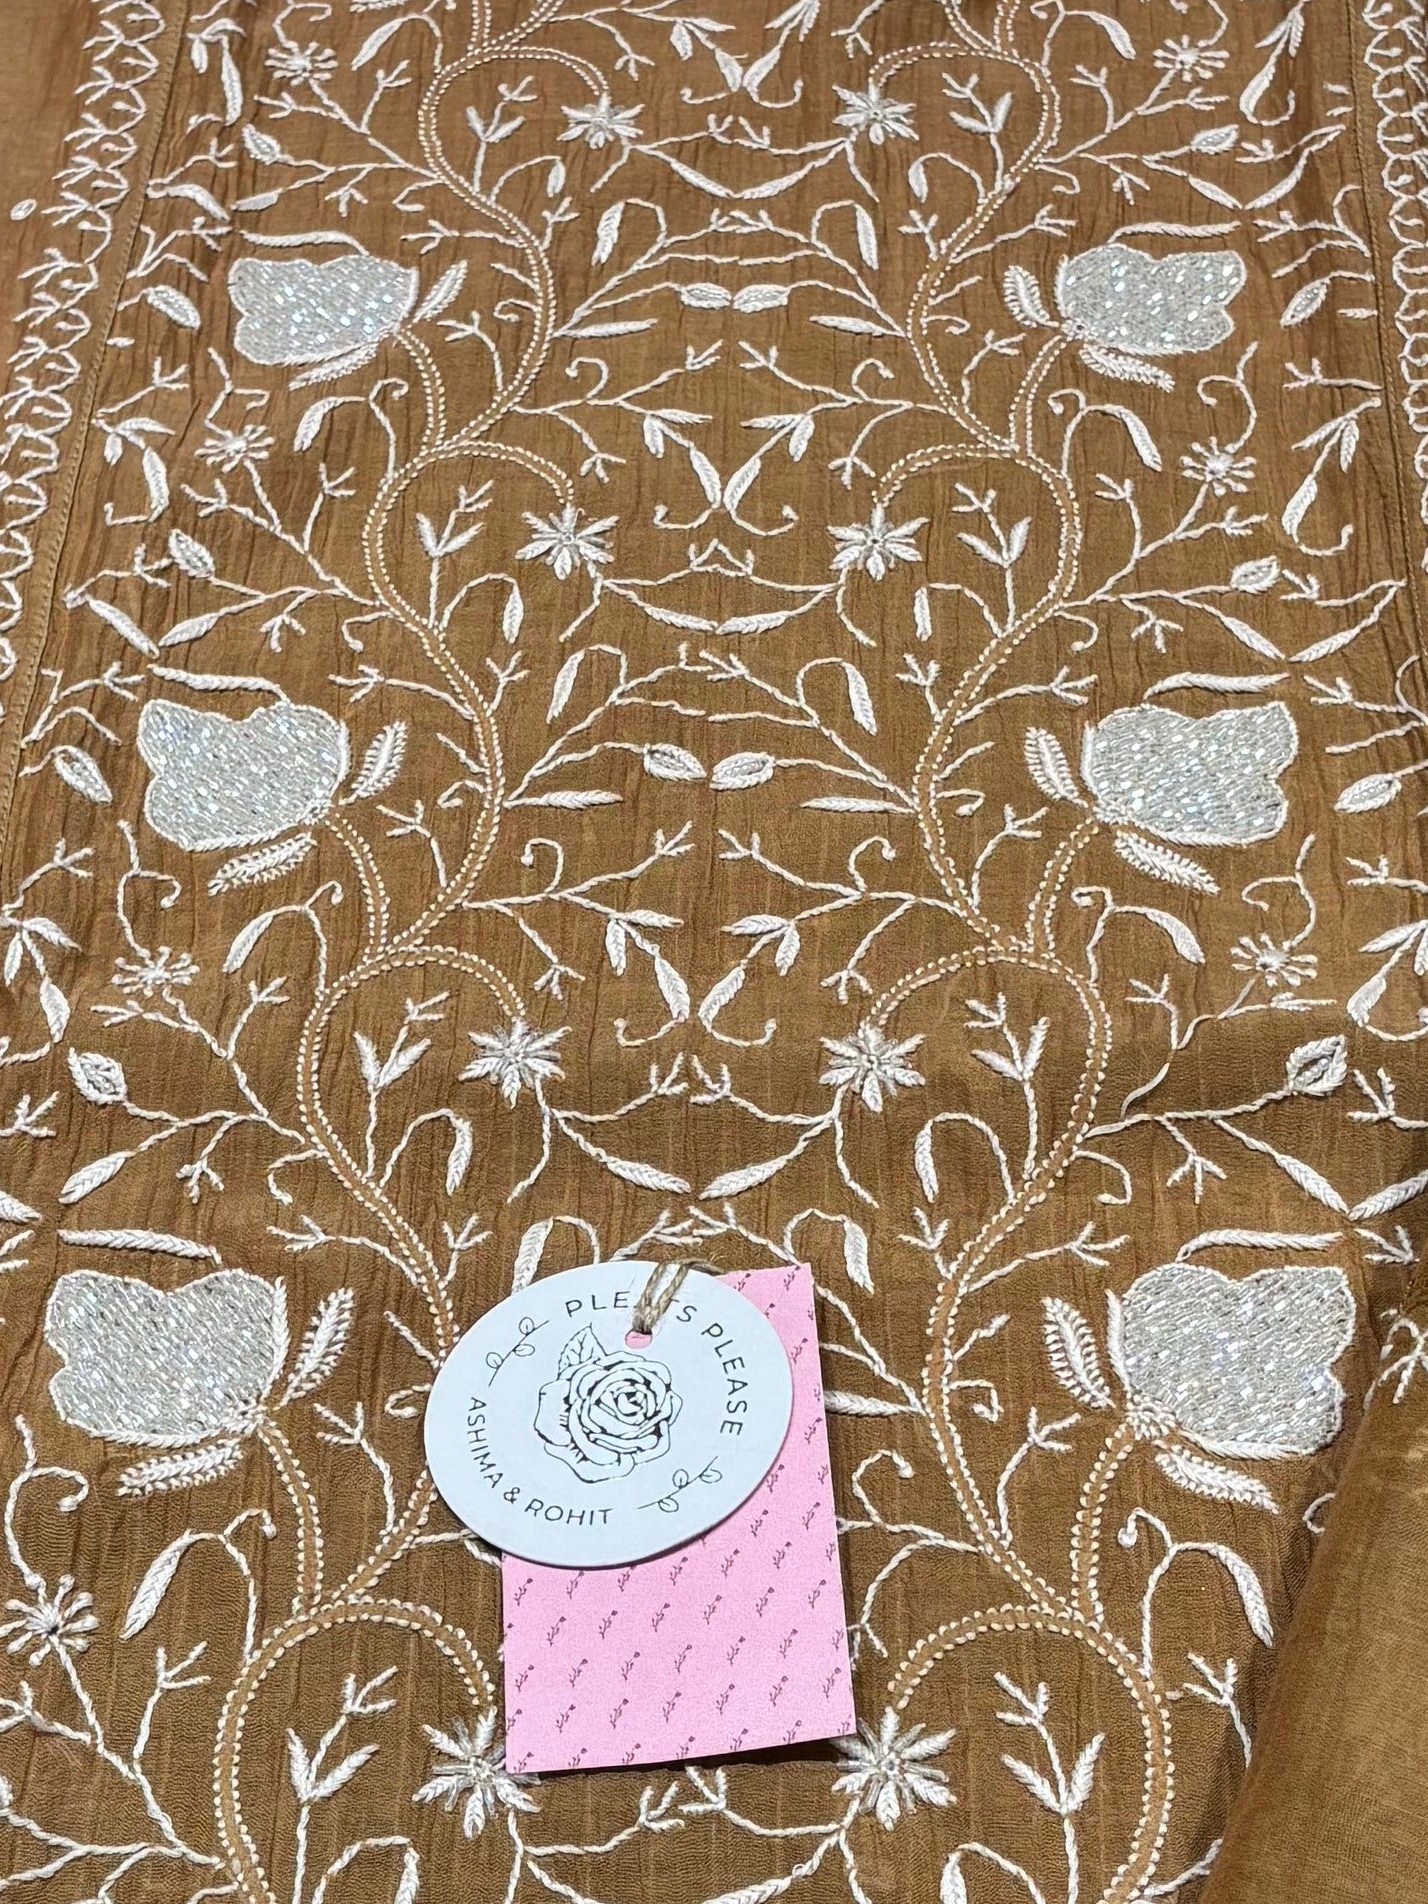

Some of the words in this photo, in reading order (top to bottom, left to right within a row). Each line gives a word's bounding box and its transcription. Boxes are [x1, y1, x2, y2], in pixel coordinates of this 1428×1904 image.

[564, 1290, 698, 1323] PLES
[700, 1322, 749, 1437] PLEASE
[466, 1396, 504, 1489] ASHIMA
[502, 1486, 521, 1505] &
[524, 1498, 614, 1526] ROHIT
